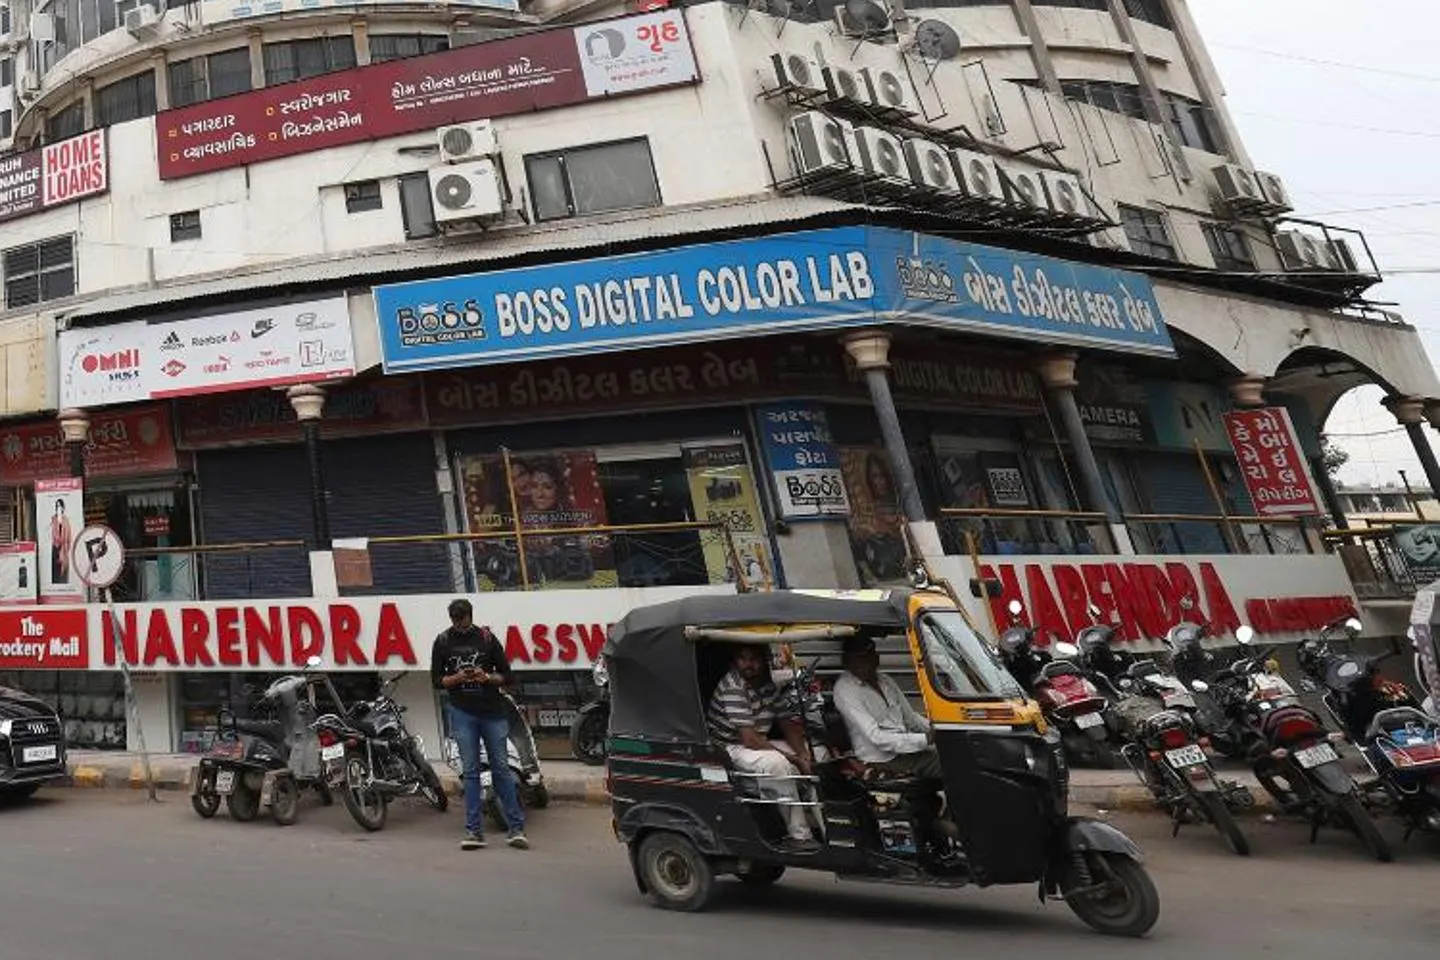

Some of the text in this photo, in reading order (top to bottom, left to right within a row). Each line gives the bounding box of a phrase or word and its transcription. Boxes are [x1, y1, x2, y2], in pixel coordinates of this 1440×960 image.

[280, 89, 352, 114] સ્વરોજગાર
[182, 114, 236, 136] પગારદાર
[46, 132, 101, 174] HOME
[46, 161, 103, 201] LOANS
[494, 250, 876, 338] BOSS DIGITAL COLOR LAB
[81, 348, 141, 374] OMNI
[1079, 403, 1140, 426] AMERA
[20, 616, 44, 637] The
[101, 602, 418, 668] NARENDRA
[48, 637, 80, 659] Mall
